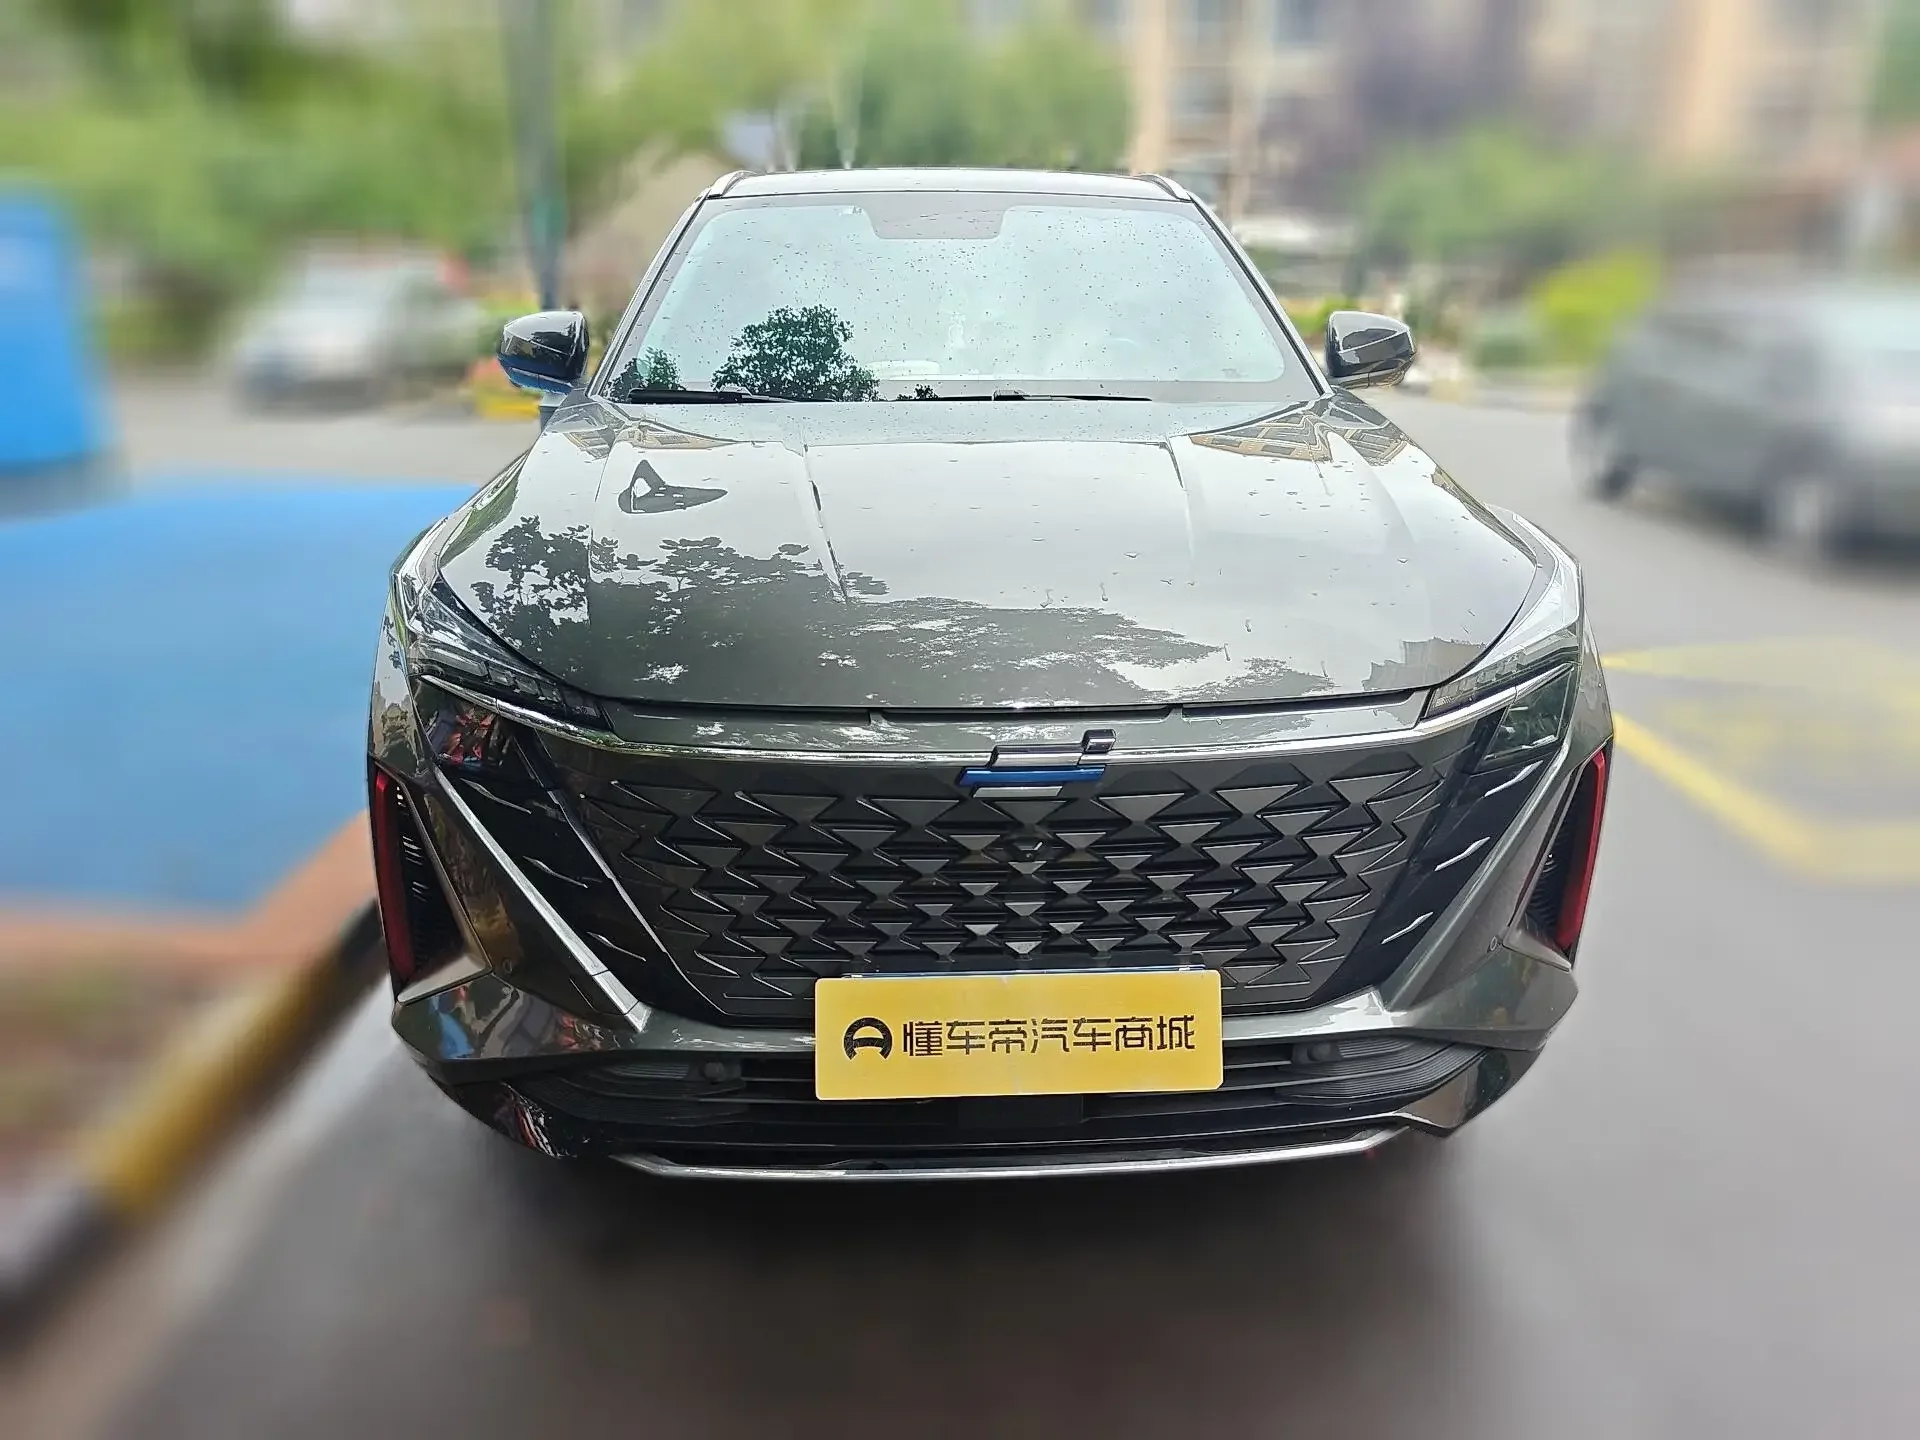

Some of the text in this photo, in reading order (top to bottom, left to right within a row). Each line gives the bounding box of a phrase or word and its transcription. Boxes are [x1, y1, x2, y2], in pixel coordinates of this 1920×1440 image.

[902, 1014, 1196, 1057] 懂车帝汽车商城
